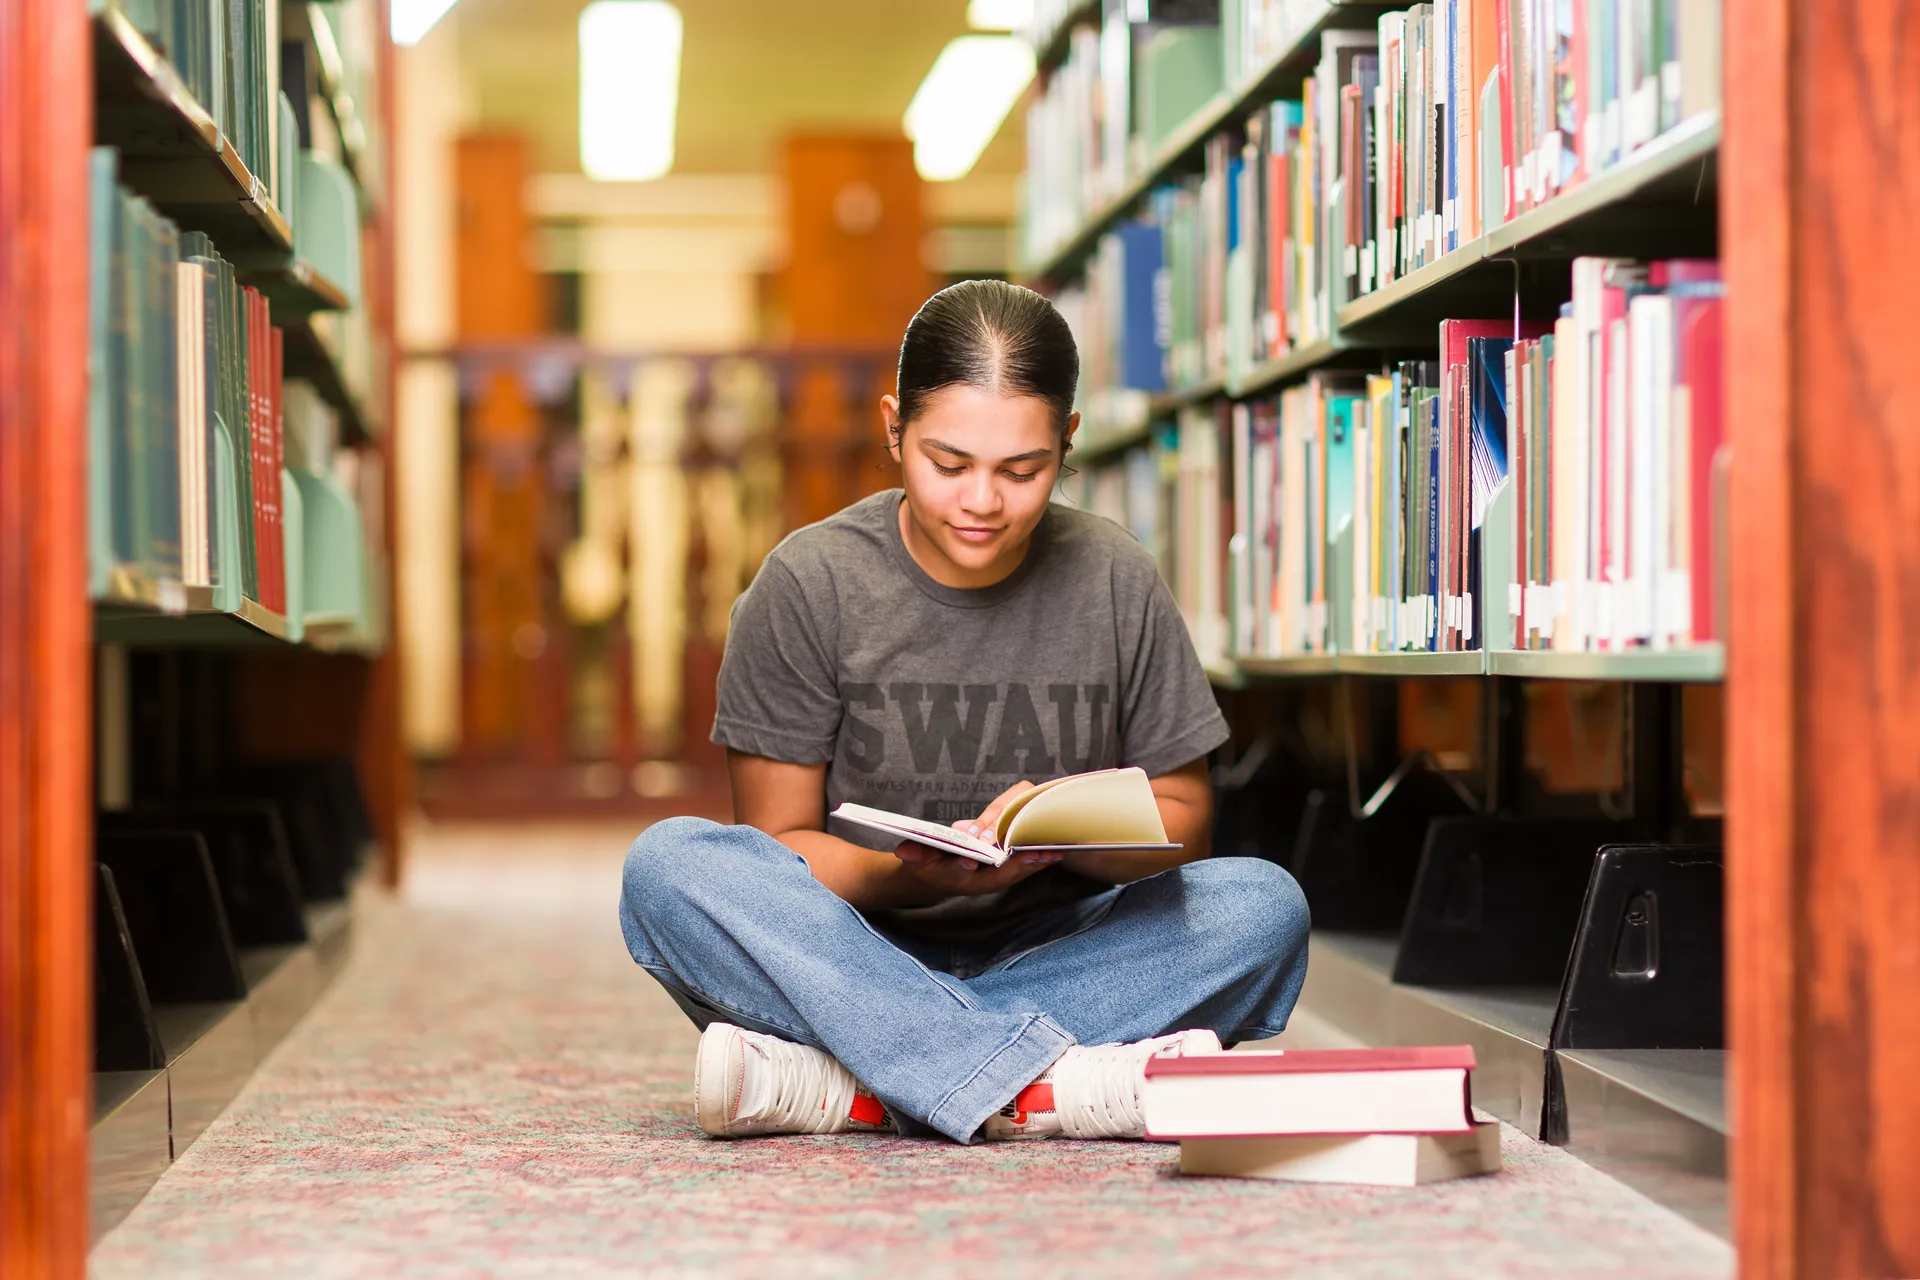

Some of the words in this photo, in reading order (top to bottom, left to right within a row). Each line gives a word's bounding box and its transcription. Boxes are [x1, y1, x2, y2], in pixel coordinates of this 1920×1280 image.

[841, 682, 1112, 775] SWAU
[951, 780, 1013, 794] ADVENT
[936, 802, 977, 820] SINCE
